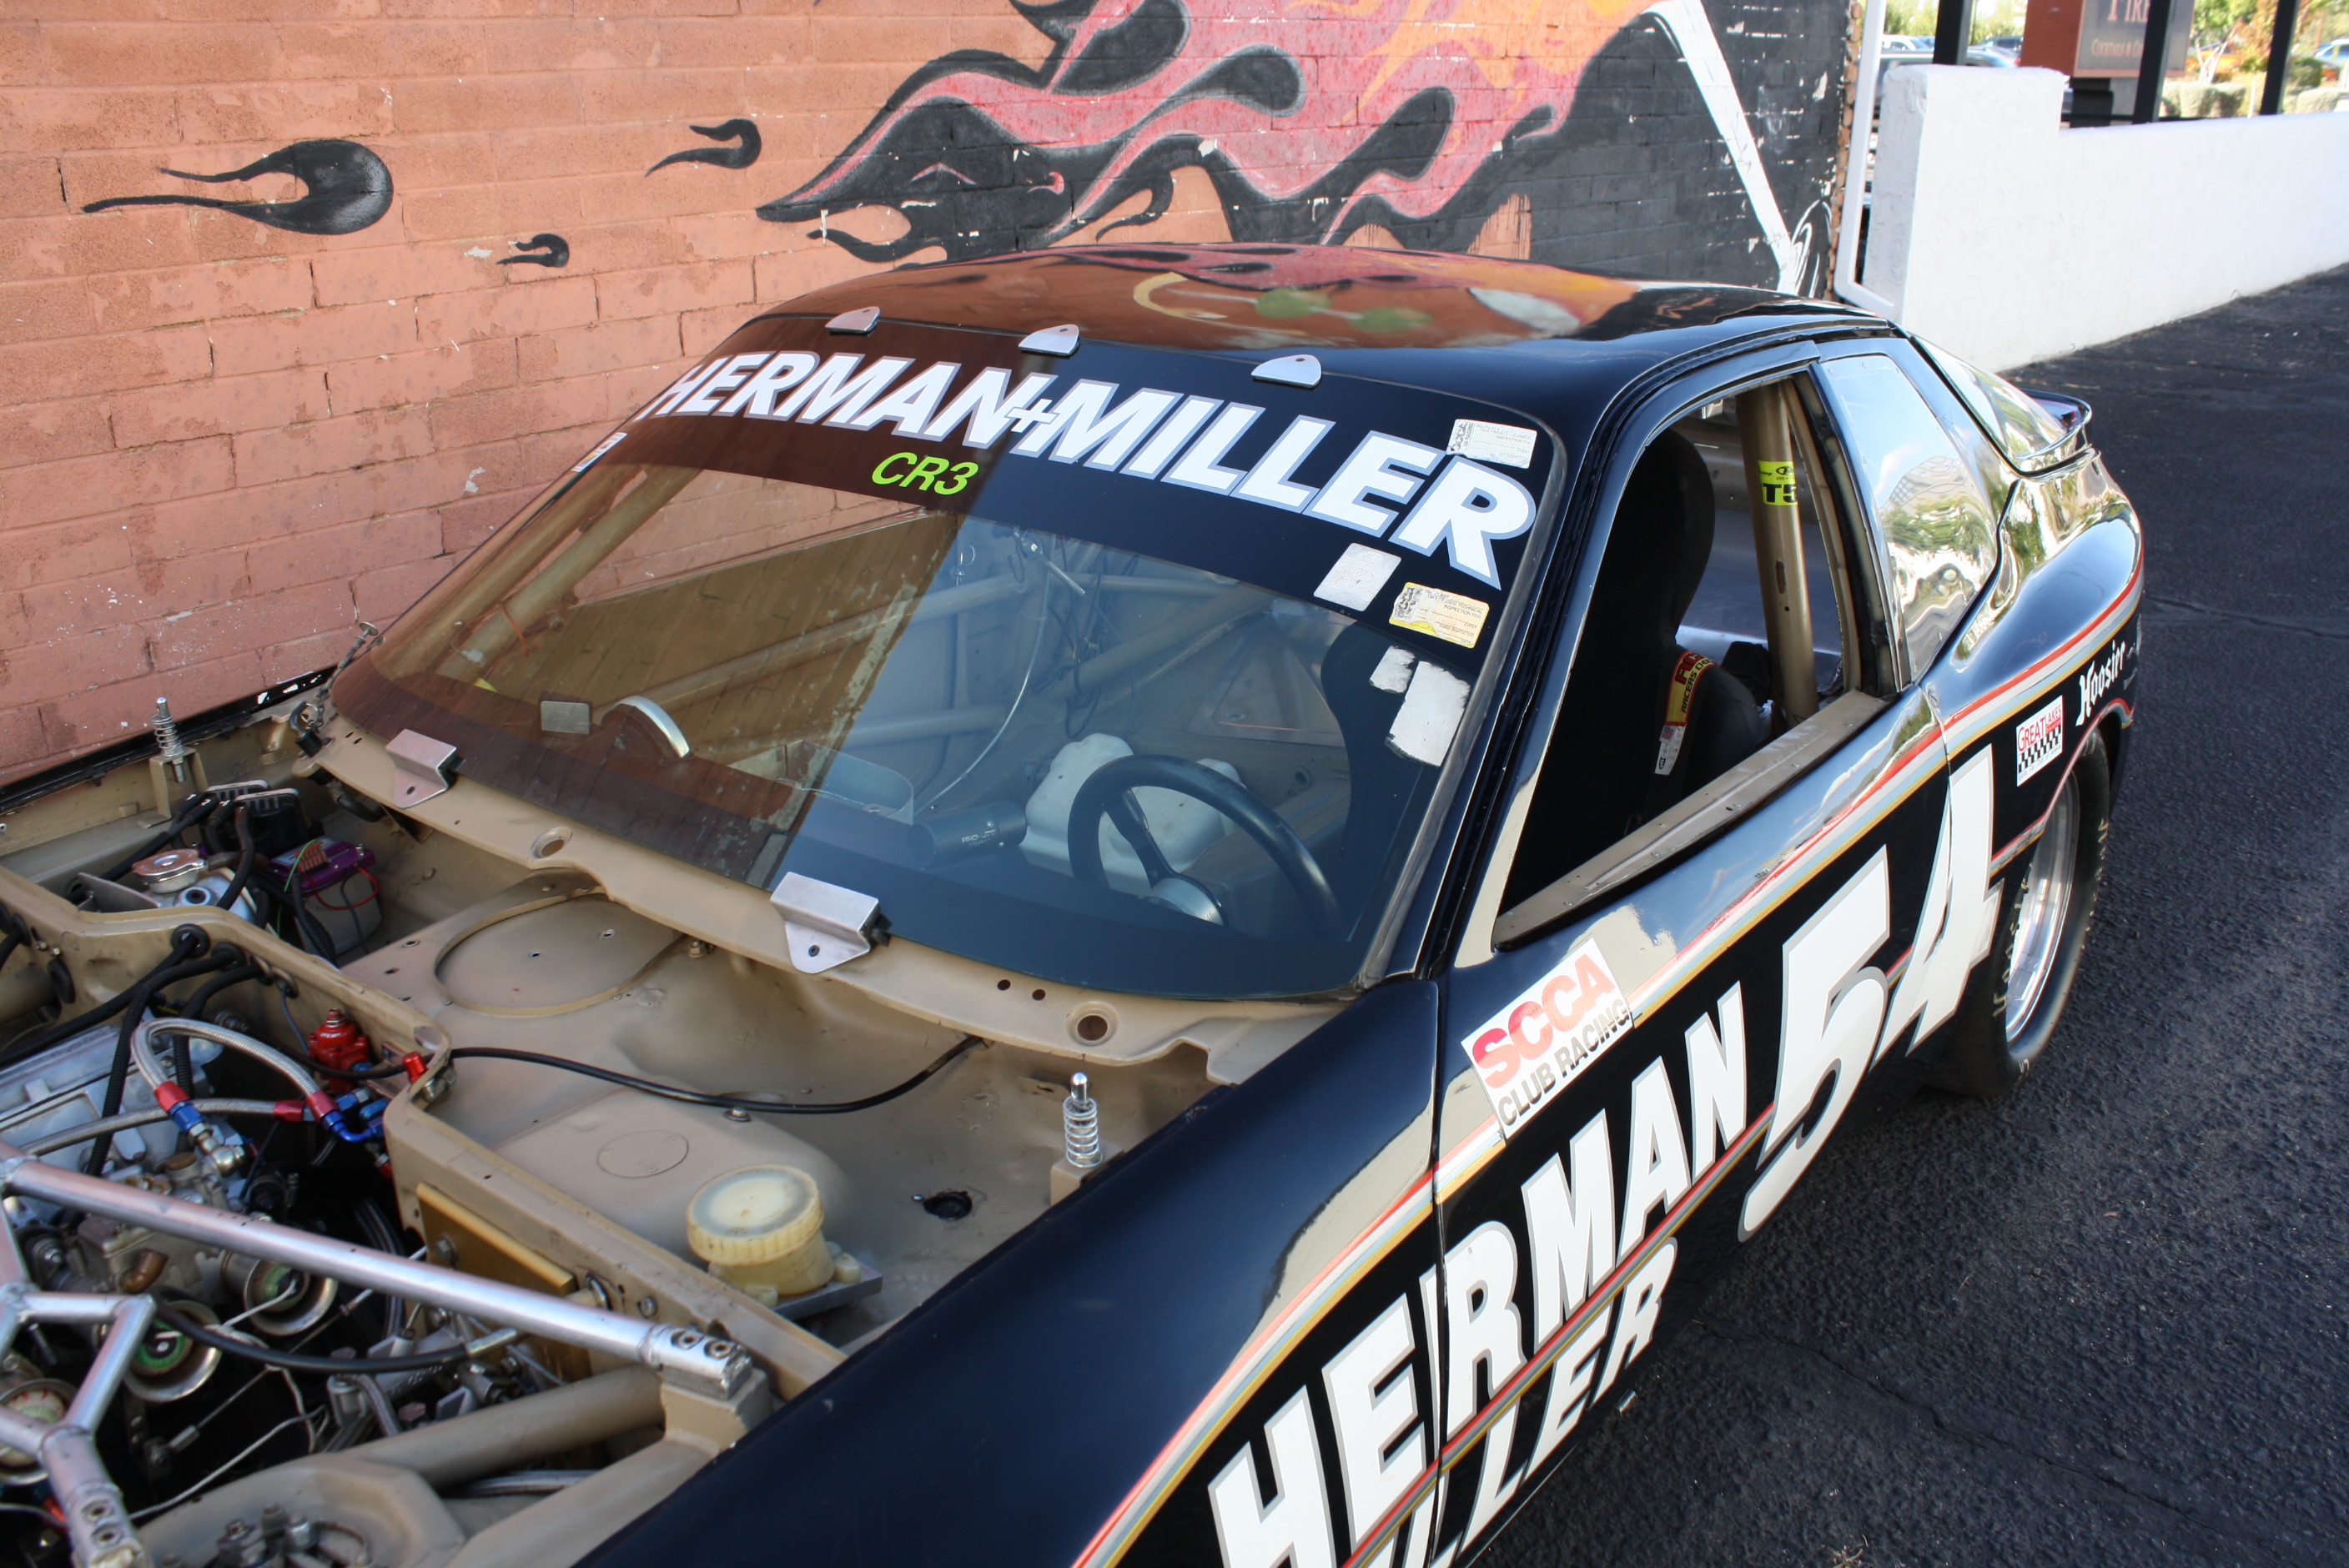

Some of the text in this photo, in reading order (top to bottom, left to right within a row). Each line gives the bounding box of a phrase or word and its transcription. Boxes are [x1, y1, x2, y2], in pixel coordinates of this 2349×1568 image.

[872, 452, 978, 495] CR3
[1761, 483, 1797, 503] T5
[2018, 715, 2046, 752] GREAT
[2045, 704, 2061, 727] LAKES
[1472, 953, 1616, 1088] SCCA
[1738, 742, 2004, 1242] 54
[1498, 998, 1631, 1126] CLUB RACING
[1208, 981, 1748, 1568] HERMAN
